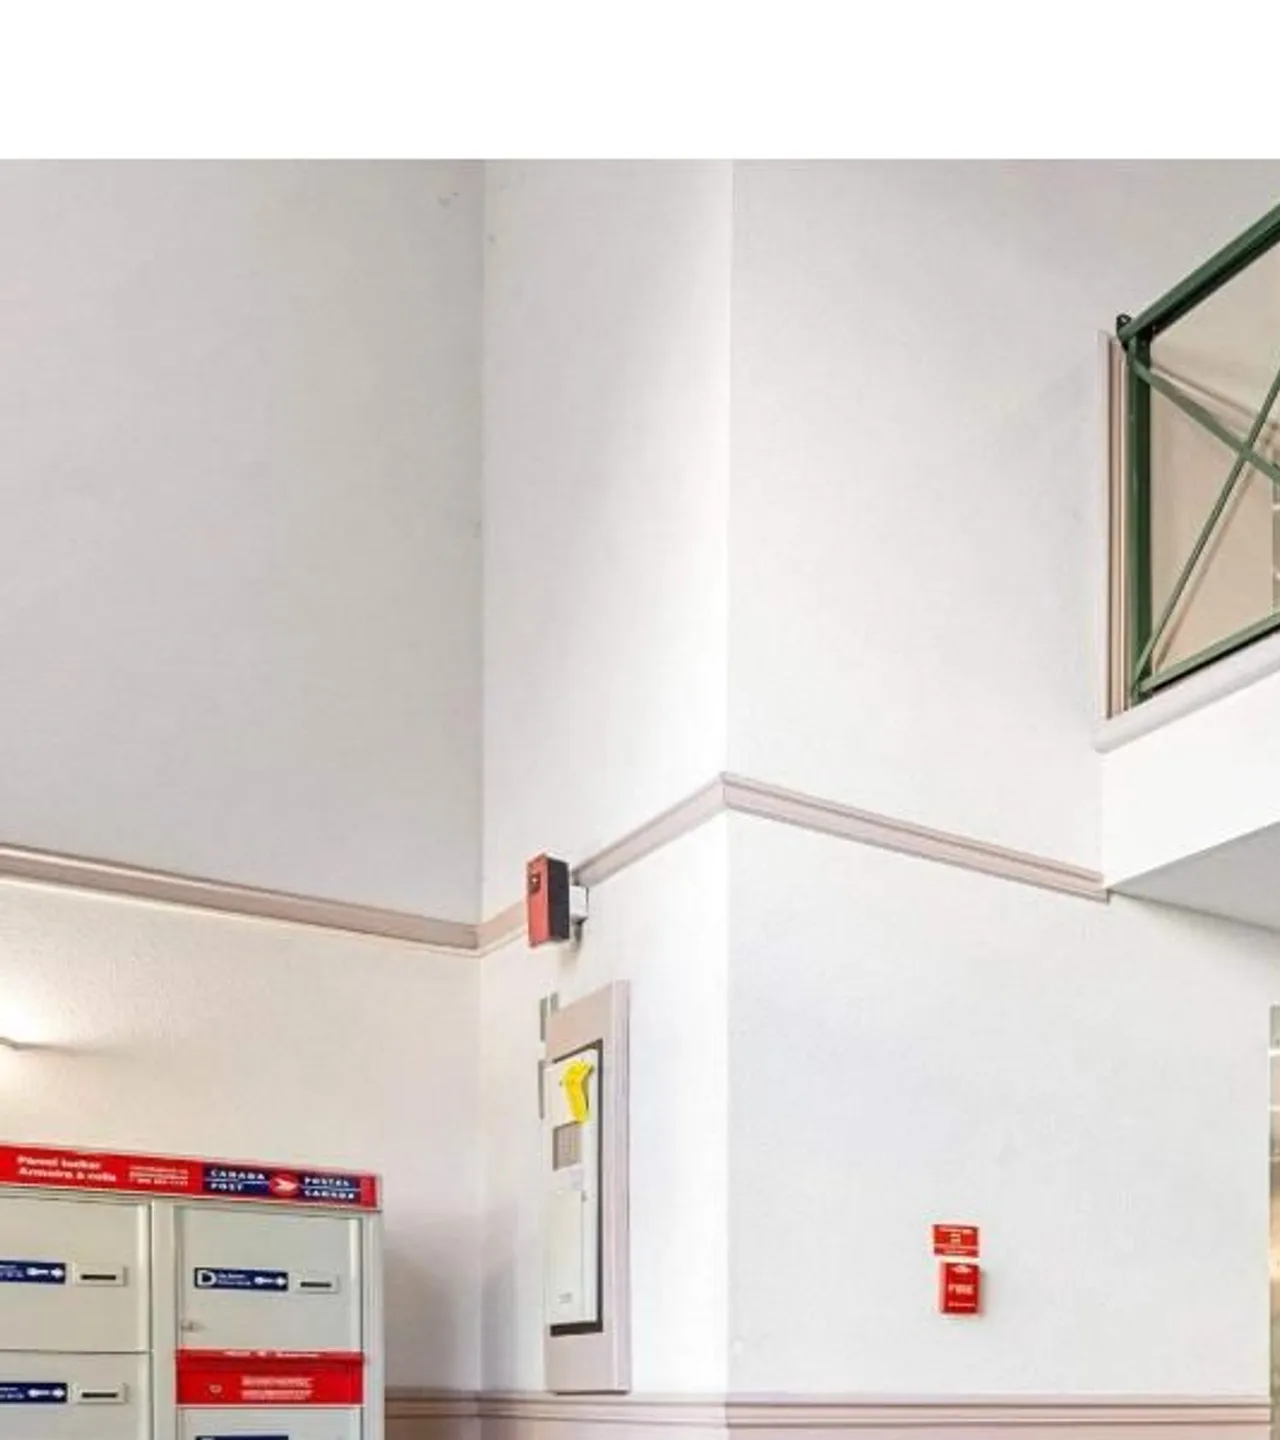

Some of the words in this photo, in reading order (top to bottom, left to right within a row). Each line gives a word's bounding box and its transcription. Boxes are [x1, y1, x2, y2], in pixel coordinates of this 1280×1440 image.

[211, 1169, 265, 1180] CANADA
[211, 1183, 243, 1191] POST
[304, 1177, 349, 1187] POSTES
[304, 1190, 355, 1200] CANADA
[198, 1269, 217, 1286] D
